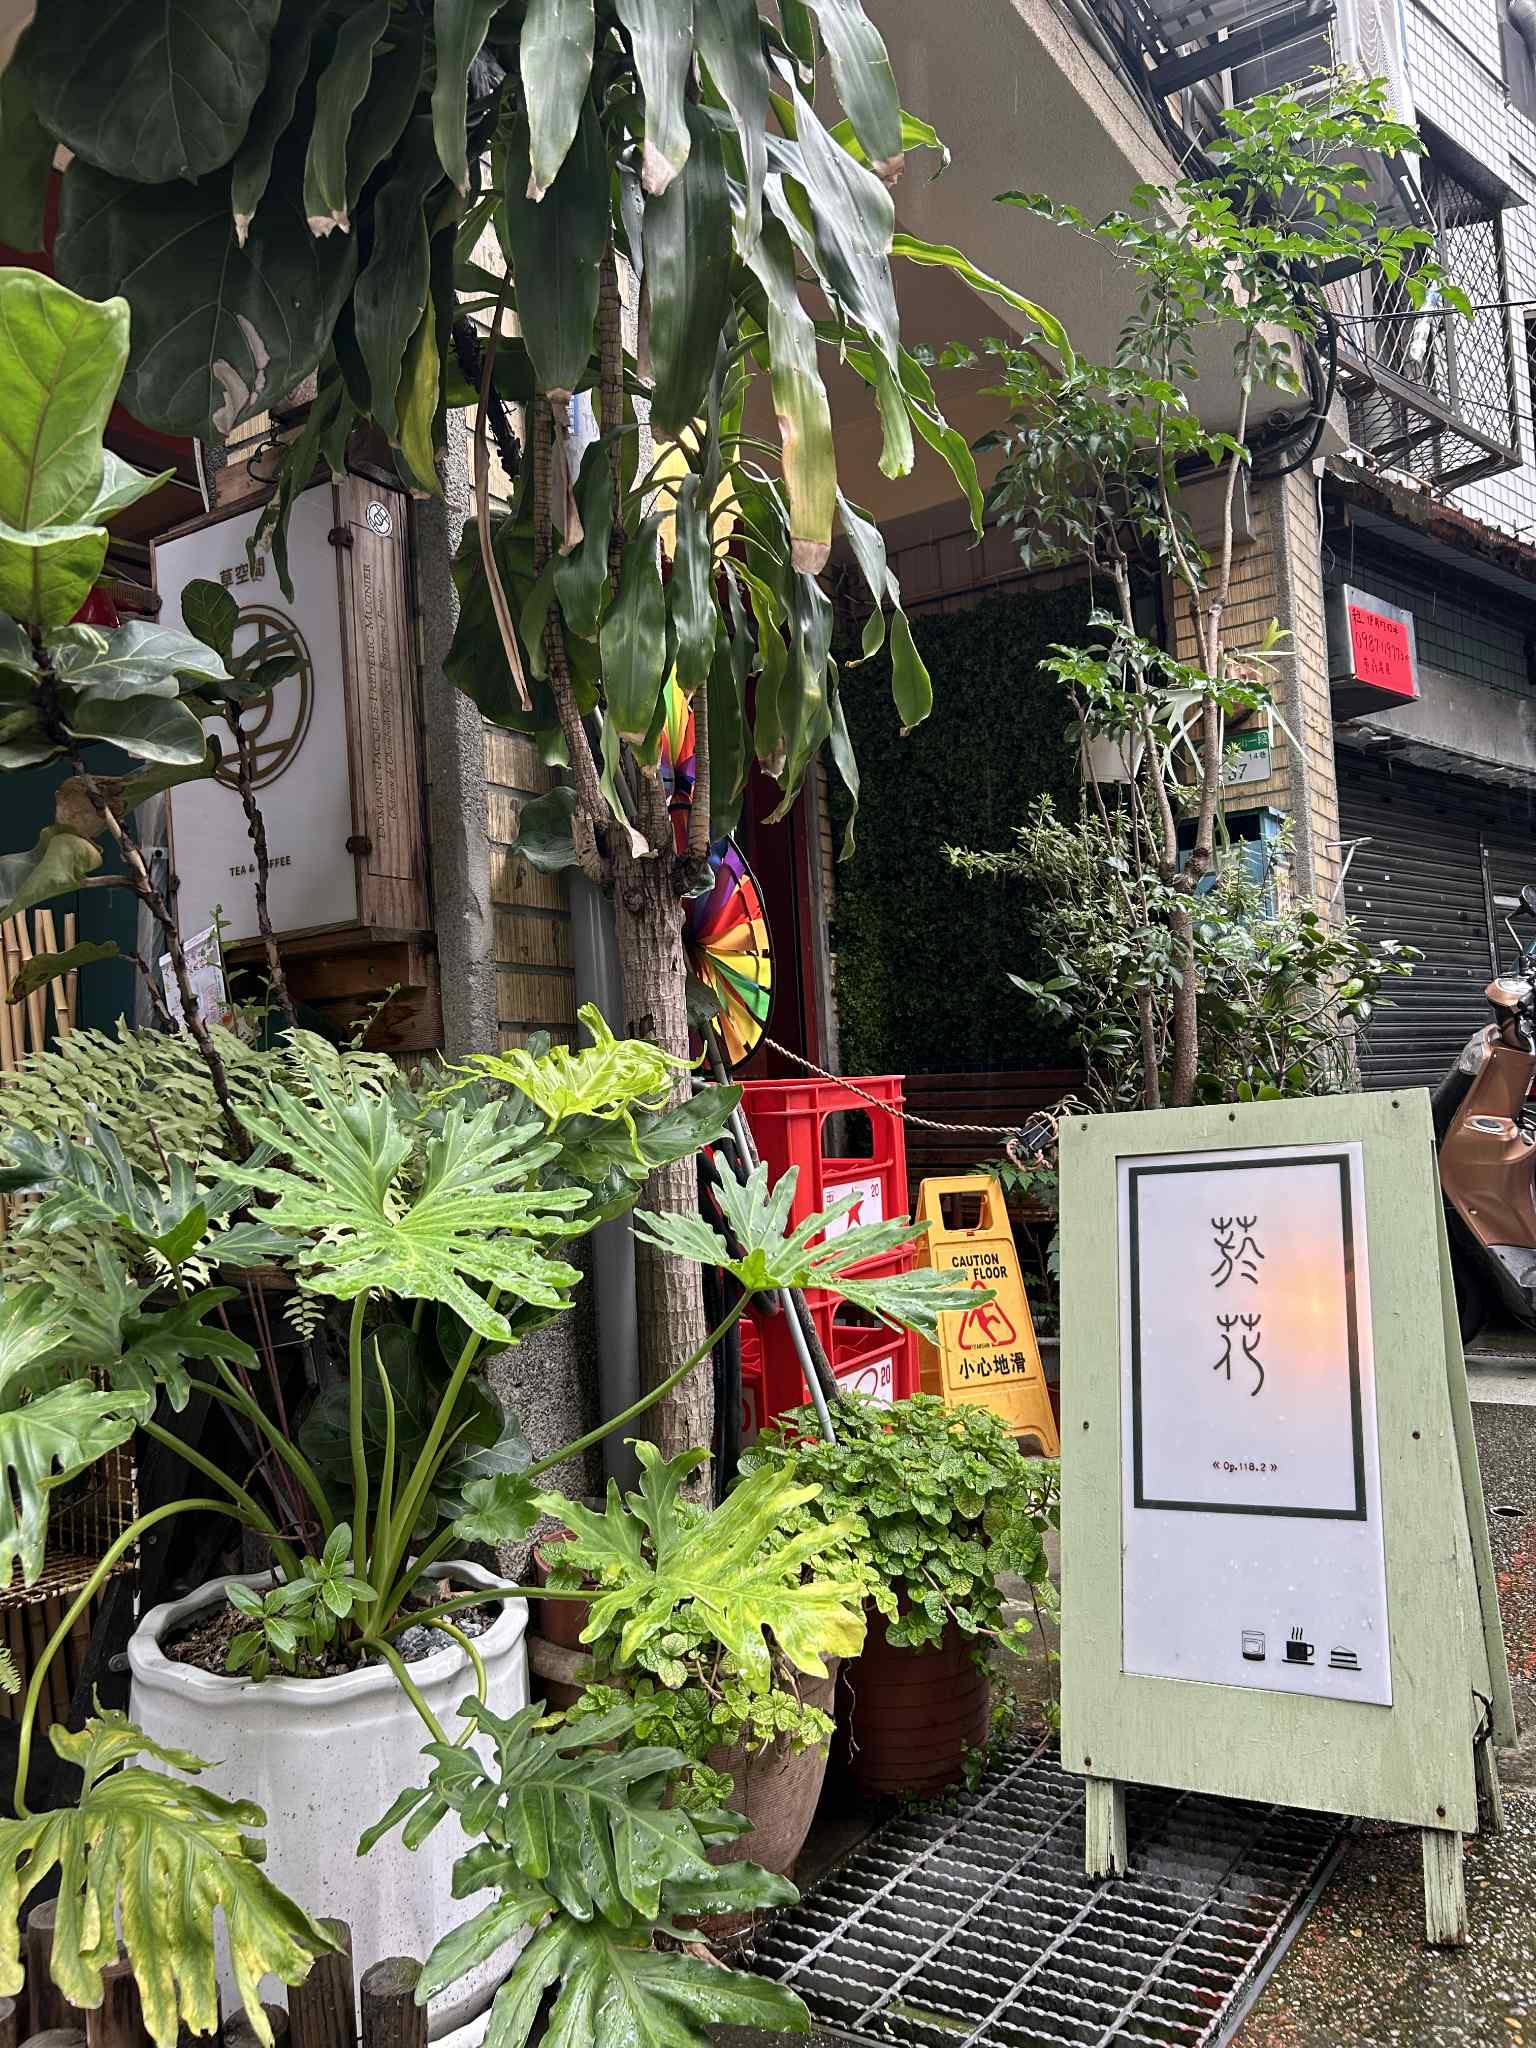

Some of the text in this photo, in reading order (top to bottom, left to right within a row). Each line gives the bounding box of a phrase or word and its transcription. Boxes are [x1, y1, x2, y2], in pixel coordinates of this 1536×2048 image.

[229, 864, 247, 877] TEA
[266, 855, 291, 869] FFEE
[952, 1253, 1000, 1268] CAUTION
[973, 1265, 1009, 1281] FLOOR
[881, 1364, 891, 1387] 20
[959, 1351, 1026, 1379] 小心地滑
